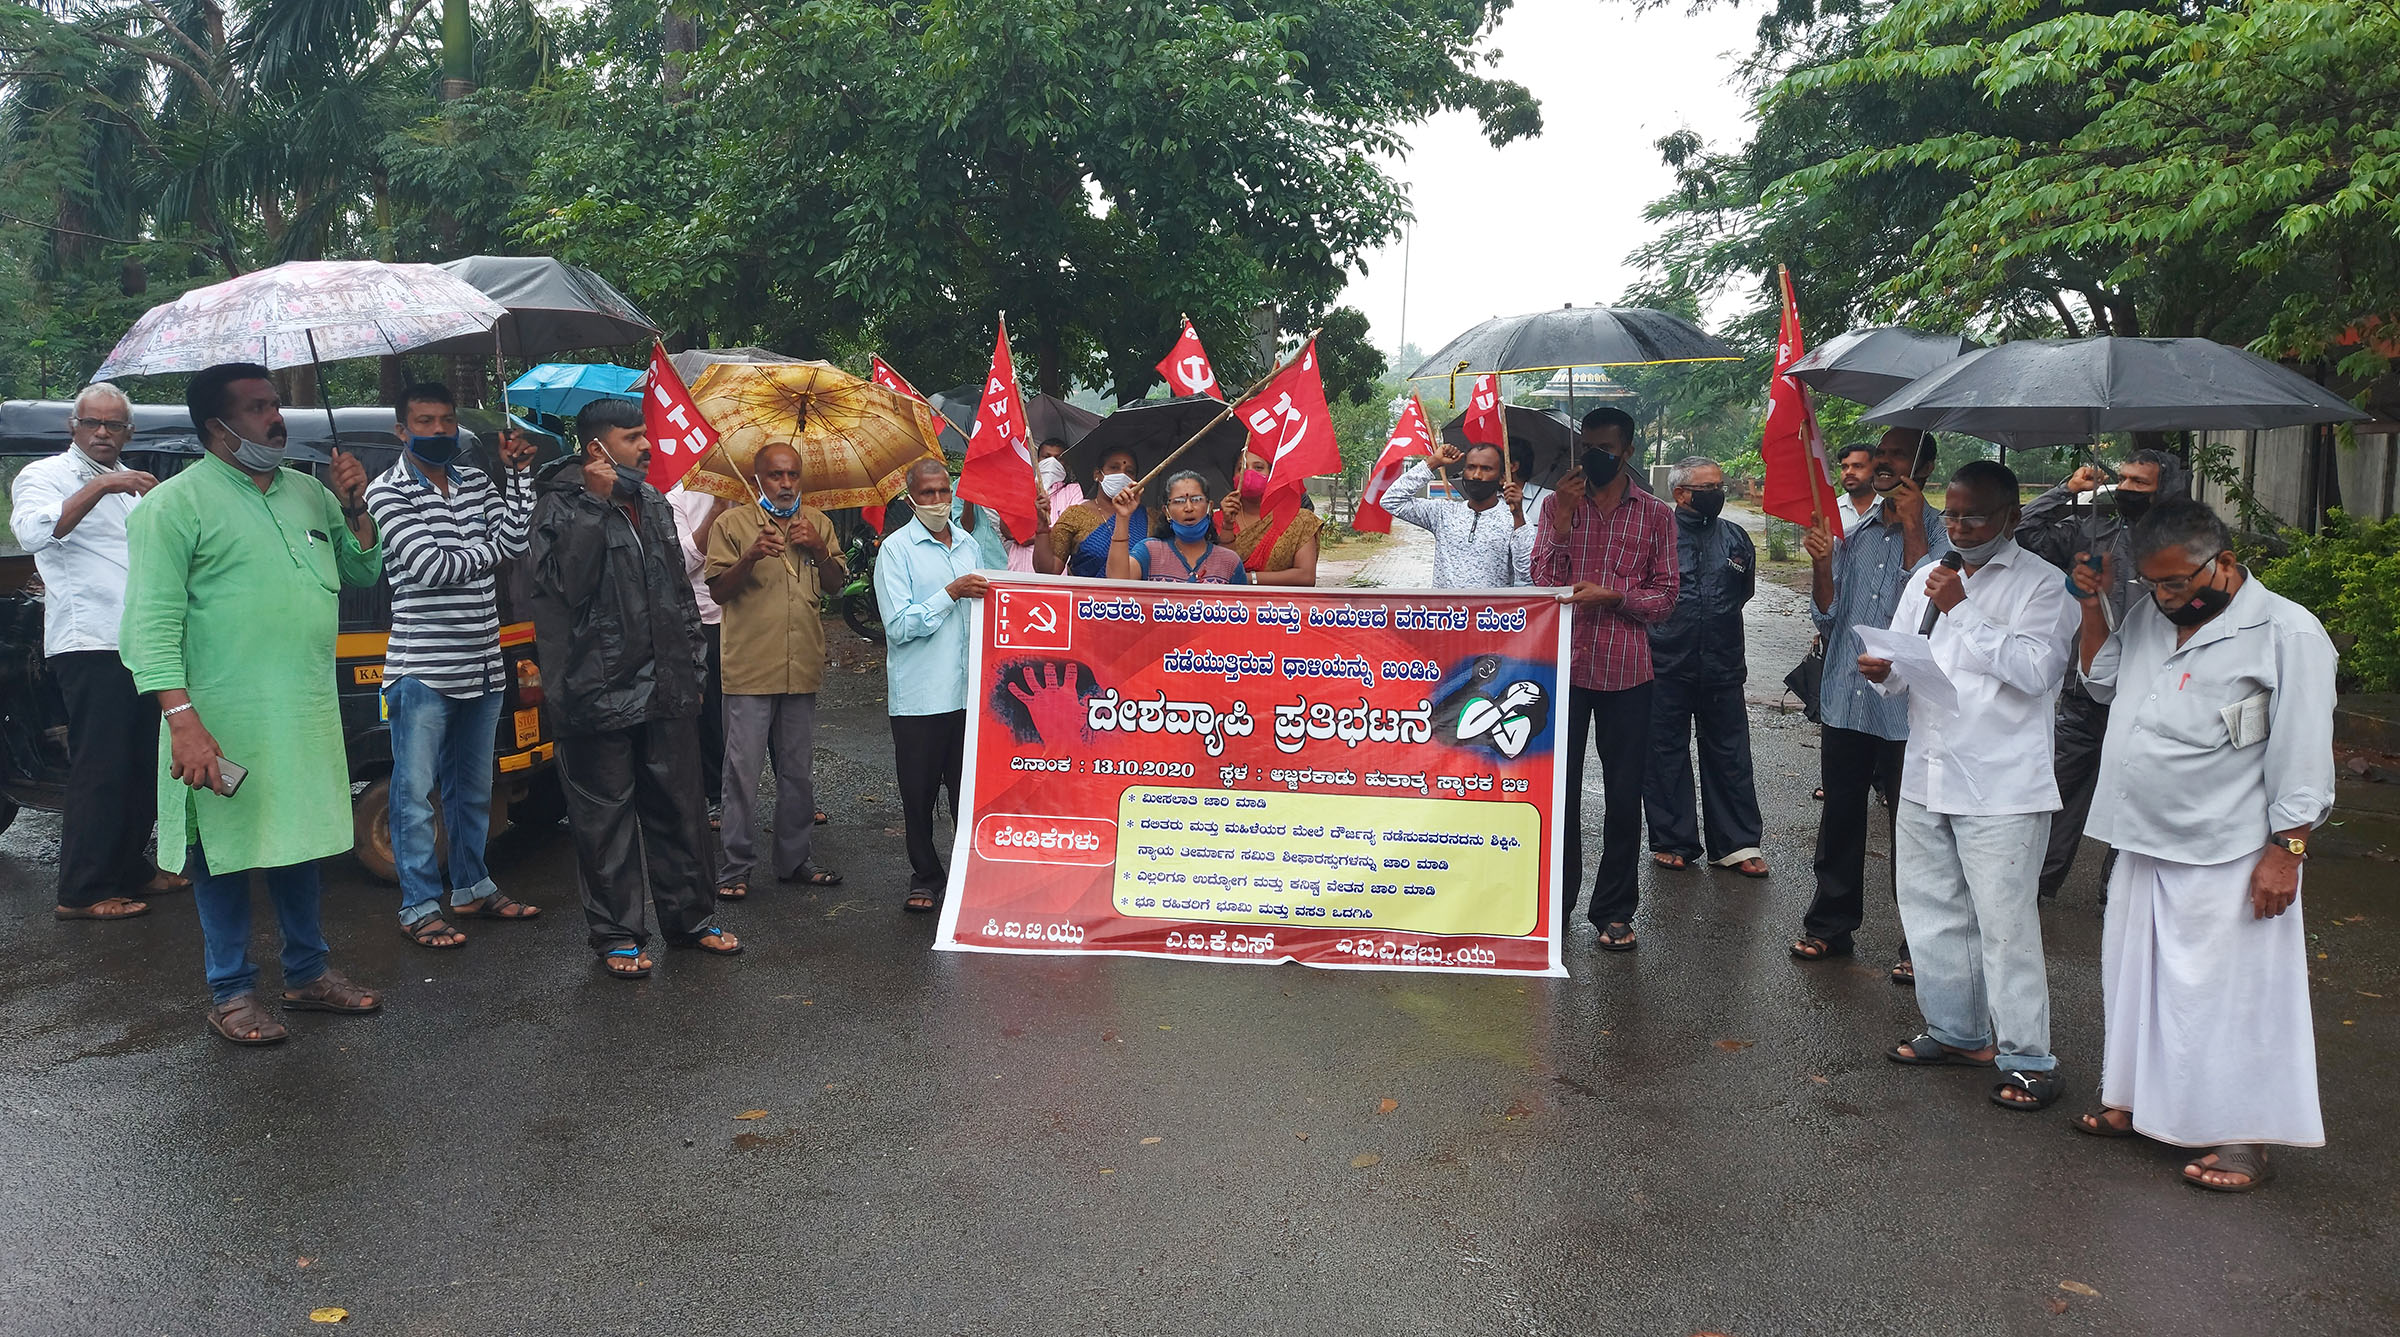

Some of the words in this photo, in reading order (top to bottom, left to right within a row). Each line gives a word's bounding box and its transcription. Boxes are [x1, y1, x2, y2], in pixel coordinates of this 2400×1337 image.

[1000, 592, 1010, 644] CITU
[1078, 596, 1145, 624] ದಲಿತರು,
[1153, 598, 1249, 624] ಮಹಿಳೆಯರು
[1256, 601, 1301, 634] ಮತ್ತು
[1308, 603, 1388, 629] ಹಿಂದುಳಿದ
[1396, 605, 1469, 631] ವರ್ಗಗಳ
[1476, 606, 1526, 632] ಮೇಲೆ
[1164, 648, 1274, 682] ನಡೆಯುತ್ತಿರುವ
[1282, 653, 1374, 687] ಧಾಳಿಯನ್ನು
[1382, 660, 1441, 682] ಖಂಡಿಸಿ
[518, 714, 536, 727] STOP
[1087, 688, 1255, 757] ದೇಶವ್ಯಾಪಿ
[1274, 694, 1432, 753] ಪ್ರತಿಭಟನೆ
[1010, 755, 1072, 772] ದಿನಾಂಕ
[1092, 758, 1195, 778] 13.10.2020
[1219, 763, 1248, 788] ಸ್ಥಳ
[1270, 766, 1357, 791] ಅಜ್ಜರಕಾಡು
[1365, 769, 1429, 795] ಹುತಾತ್ಮ
[1437, 773, 1493, 796] ಸ್ಮಾರಕ
[1502, 777, 1529, 792] ಬಳಿ
[1142, 793, 1198, 806] ಮೀಸಲಾತಿ
[1204, 796, 1230, 807] ಜಾರಿ
[1235, 797, 1267, 809] ಮಾಡಿ
[994, 825, 1100, 850] ಬೇಡಿಕೆಗಳು
[1140, 818, 1183, 831] ದಲಿತರು
[1190, 821, 1219, 836] ಮತ್ತು
[1225, 821, 1286, 836] ಮಹಿಳೆಯರ
[1292, 824, 1324, 838] ಮೇಲೆ
[1138, 845, 1174, 860] ನ್ಯಾಯ
[1241, 848, 1275, 862] ಸಮಿತಿ
[1383, 857, 1410, 869] ಜಾರಿ
[1417, 858, 1449, 870] ಮಾಡಿ
[1192, 873, 1247, 891] ಉದ್ಯೋಗ
[1253, 877, 1283, 892] ಮತ್ತು
[1327, 880, 1364, 894] ವೇತನ
[1370, 883, 1397, 894] ಜಾರಿ
[1403, 885, 1436, 896] ಮಾಡಿ
[1216, 900, 1252, 913] ಭೂಮಿ
[1258, 903, 1289, 918] ಮತ್ತು
[1295, 905, 1326, 917] ವಸತಿ
